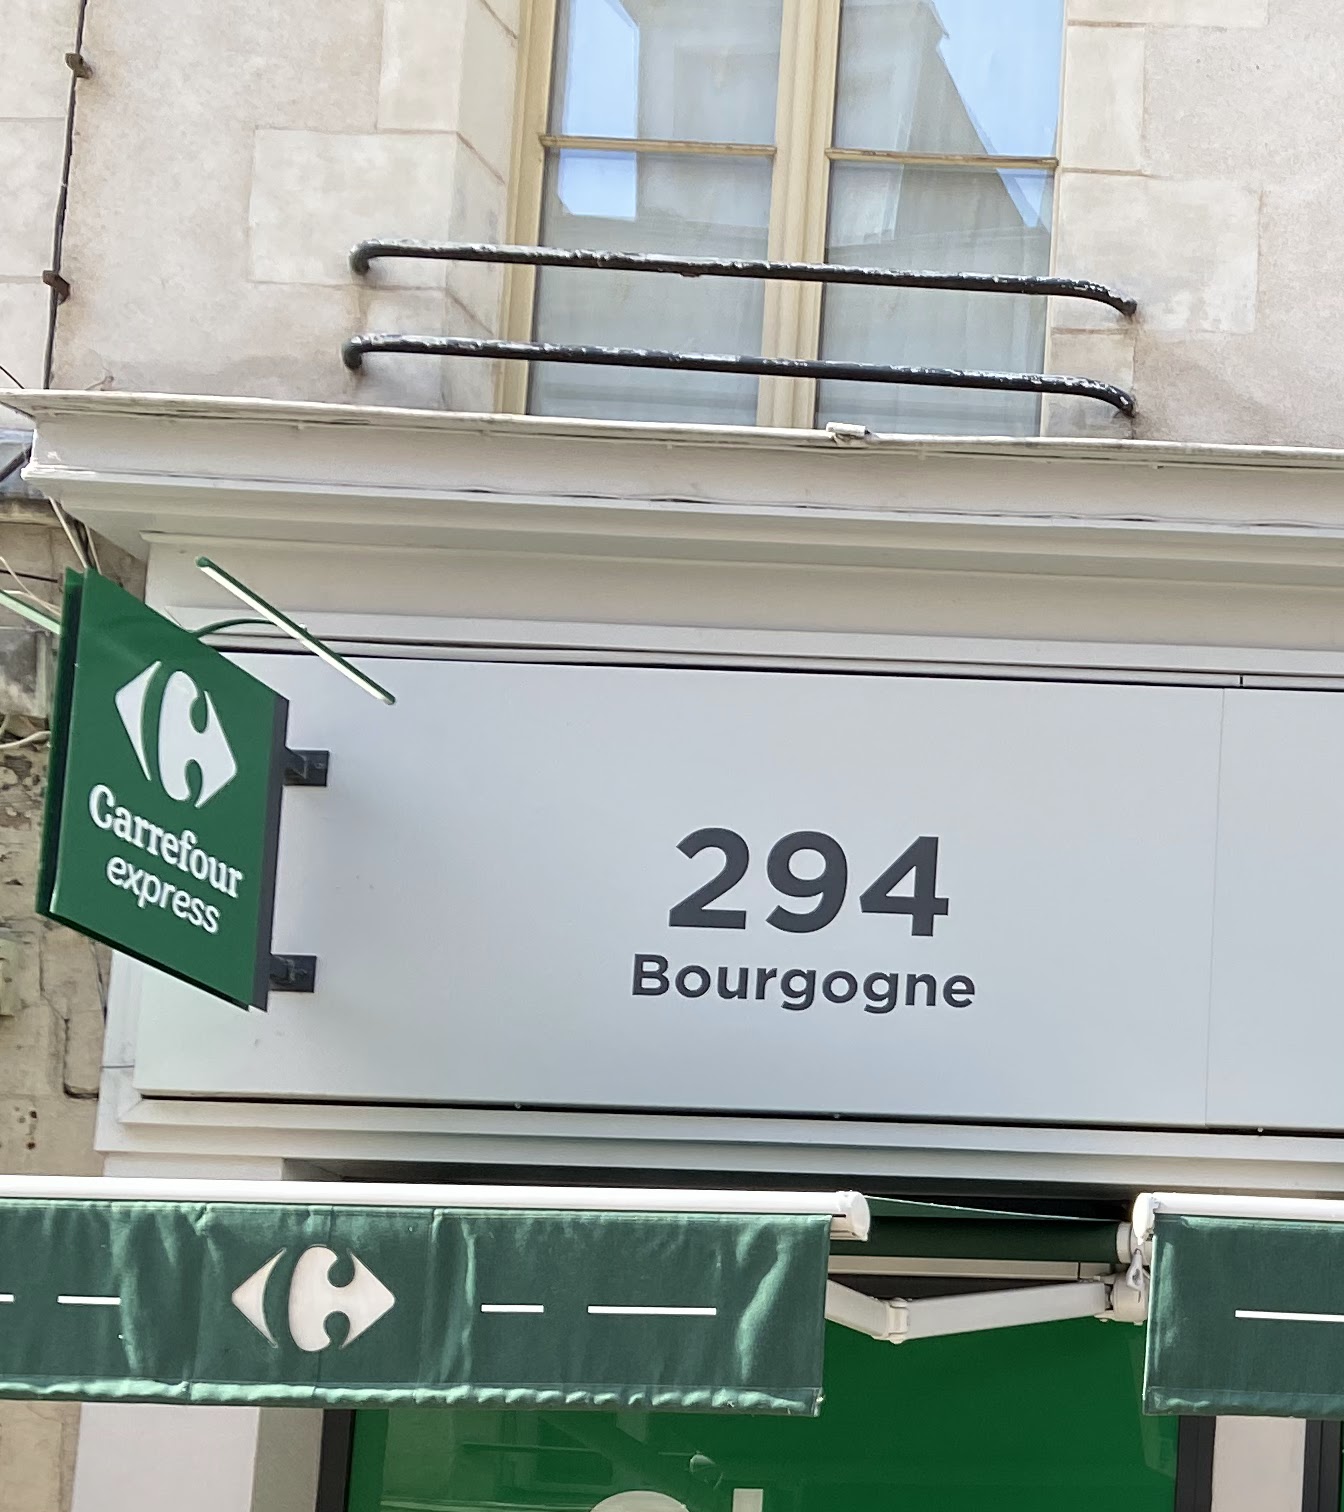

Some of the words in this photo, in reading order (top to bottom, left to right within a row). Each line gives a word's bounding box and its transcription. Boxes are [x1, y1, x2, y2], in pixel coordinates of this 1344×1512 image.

[88, 783, 244, 899] Carrefour
[668, 826, 950, 937] 294
[106, 854, 220, 934] express
[631, 953, 976, 1014] Bourgogne
